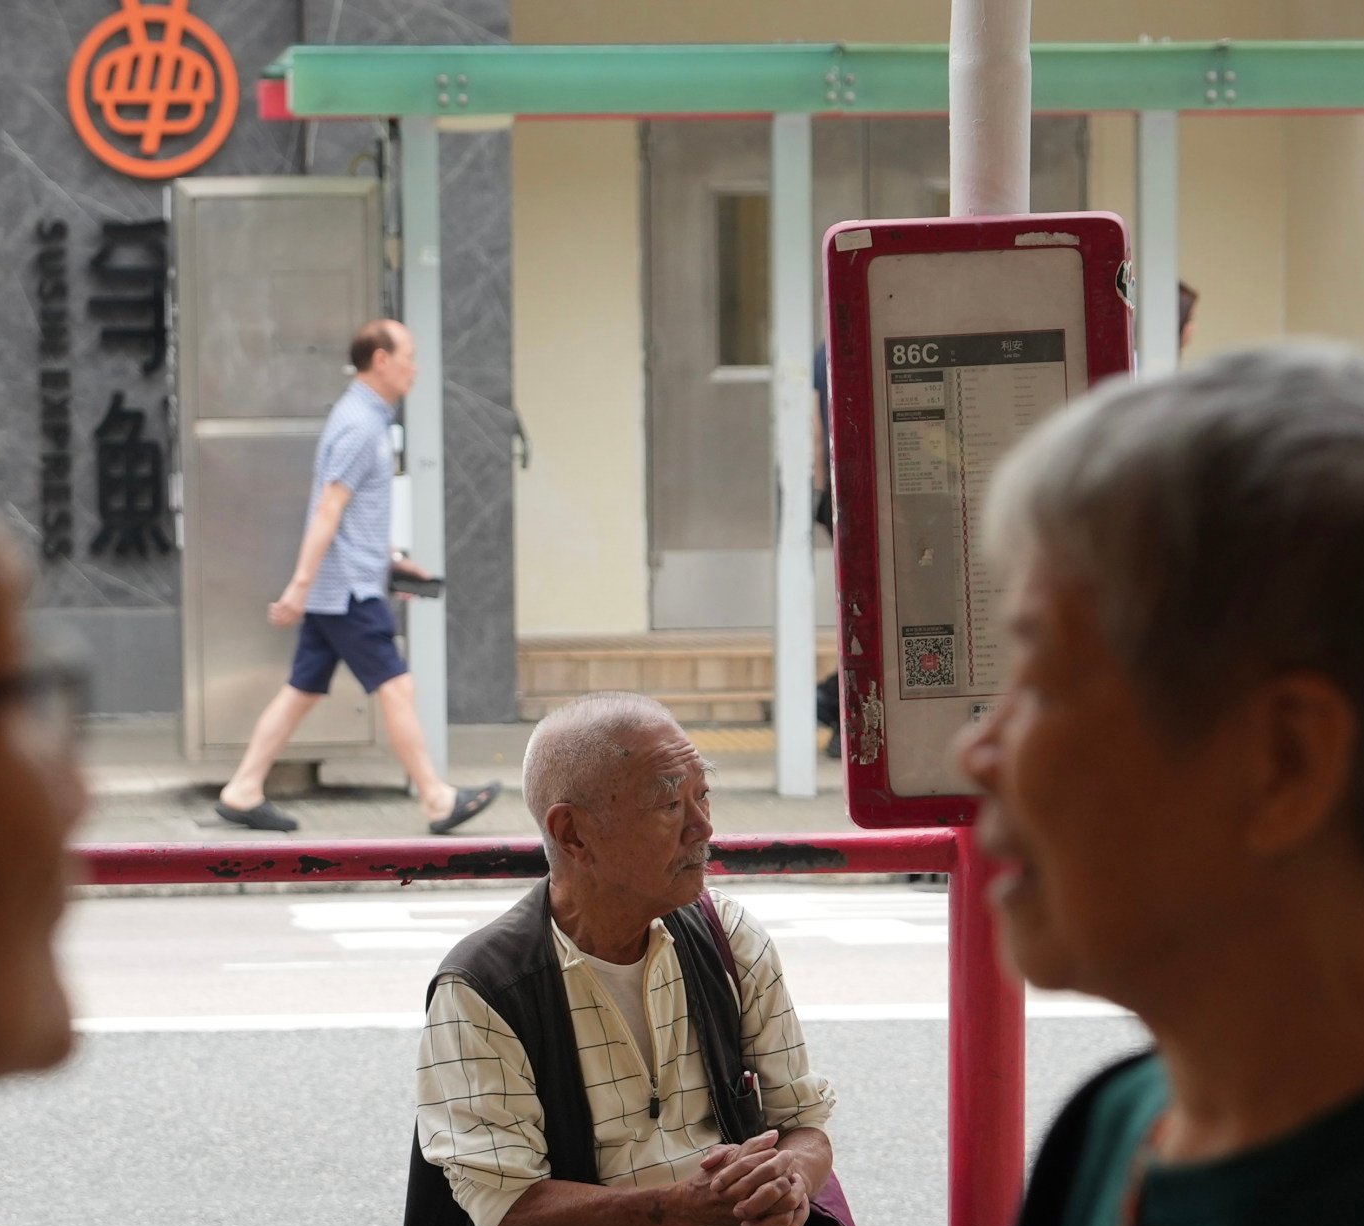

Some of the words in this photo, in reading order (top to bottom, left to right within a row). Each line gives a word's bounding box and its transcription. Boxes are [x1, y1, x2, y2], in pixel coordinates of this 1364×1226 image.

[37, 218, 69, 358] SUSHI
[892, 343, 939, 365] 86C
[1001, 340, 1023, 351] 利安
[40, 368, 72, 558] EXPRESS
